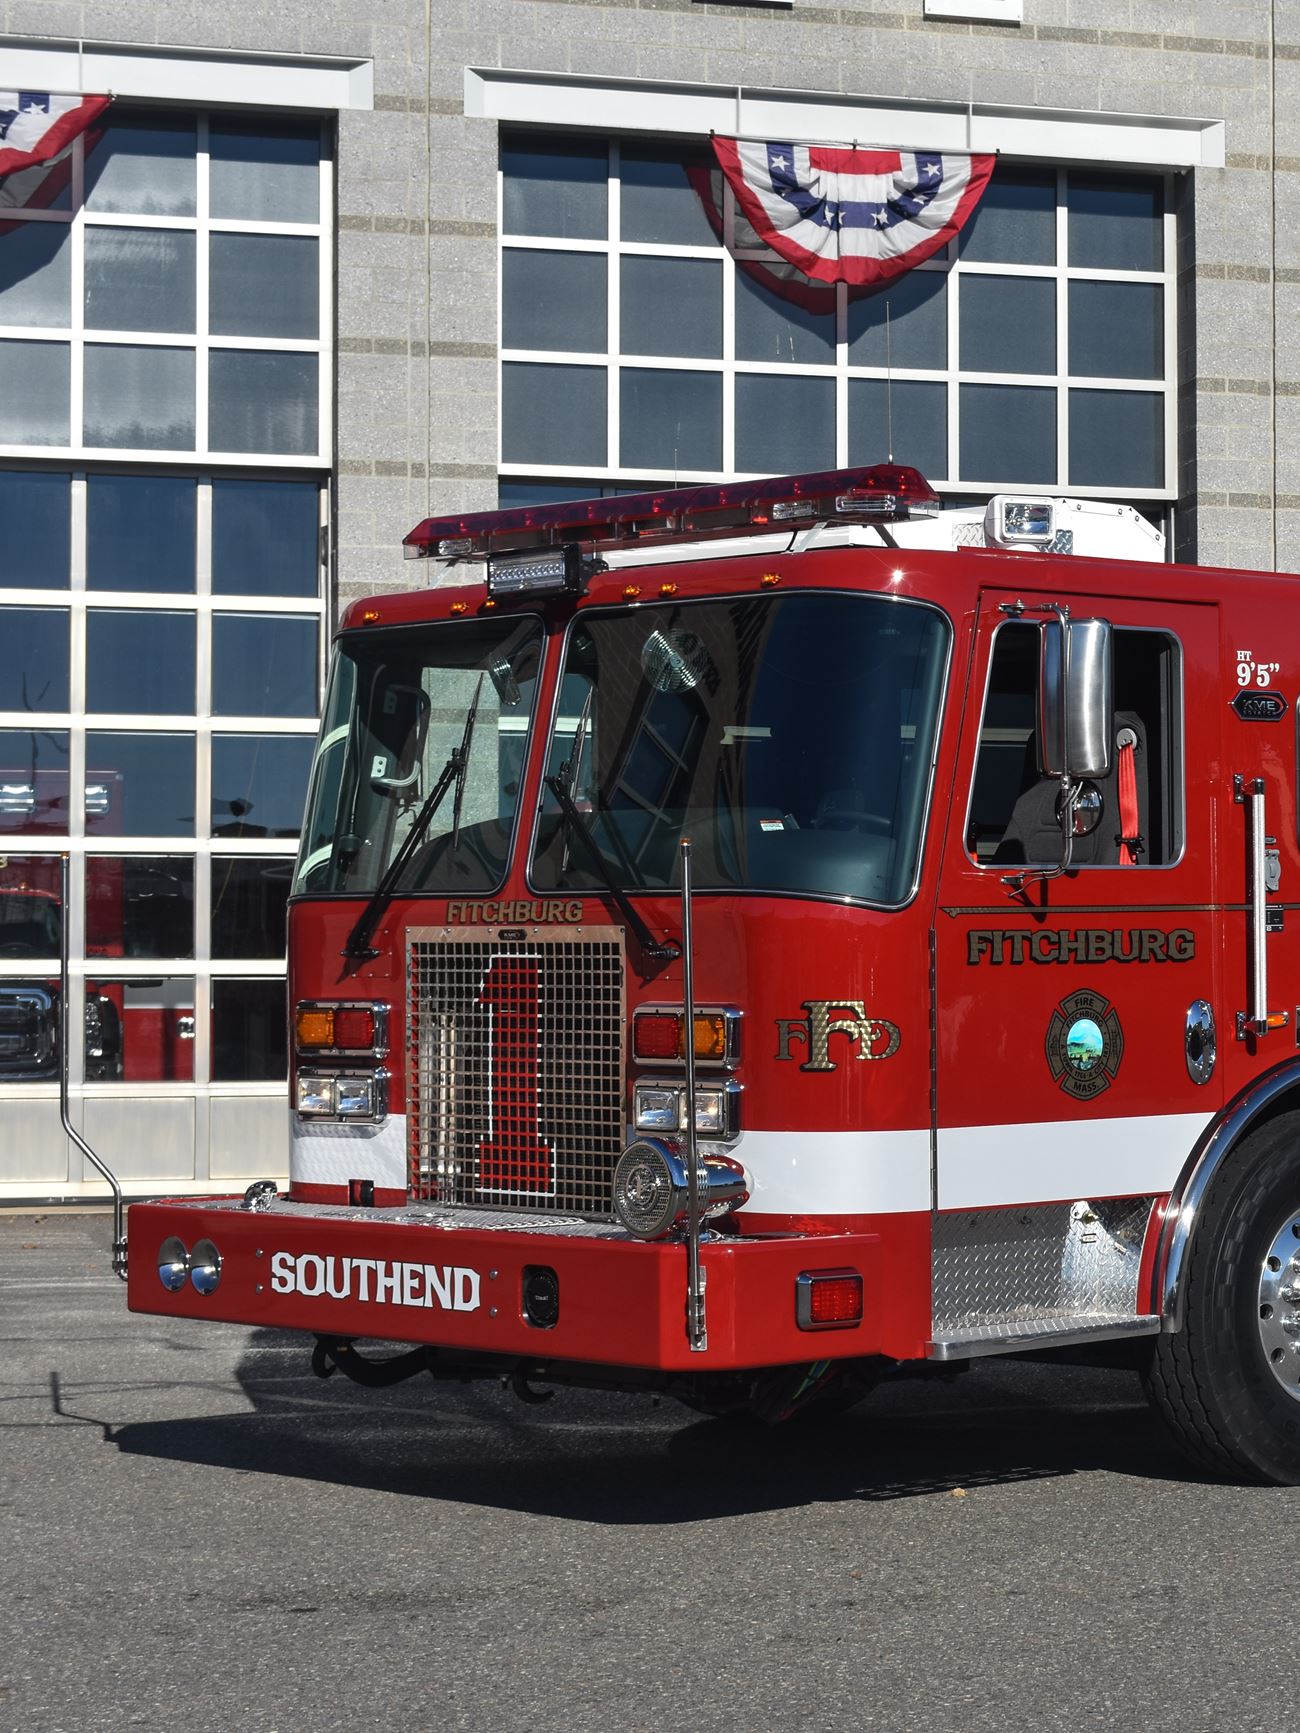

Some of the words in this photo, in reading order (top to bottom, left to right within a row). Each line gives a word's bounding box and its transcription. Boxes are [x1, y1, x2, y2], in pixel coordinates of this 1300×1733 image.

[1237, 651, 1251, 662] HT
[1243, 700, 1276, 711] KME
[446, 900, 584, 924] FITCHBURG
[967, 929, 1196, 966] FITCHBURG
[1075, 997, 1095, 1008] FIRE
[1065, 1010, 1103, 1028] FITCHBURG
[474, 953, 556, 1197] 1
[270, 1252, 481, 1313] SOUTHEND
